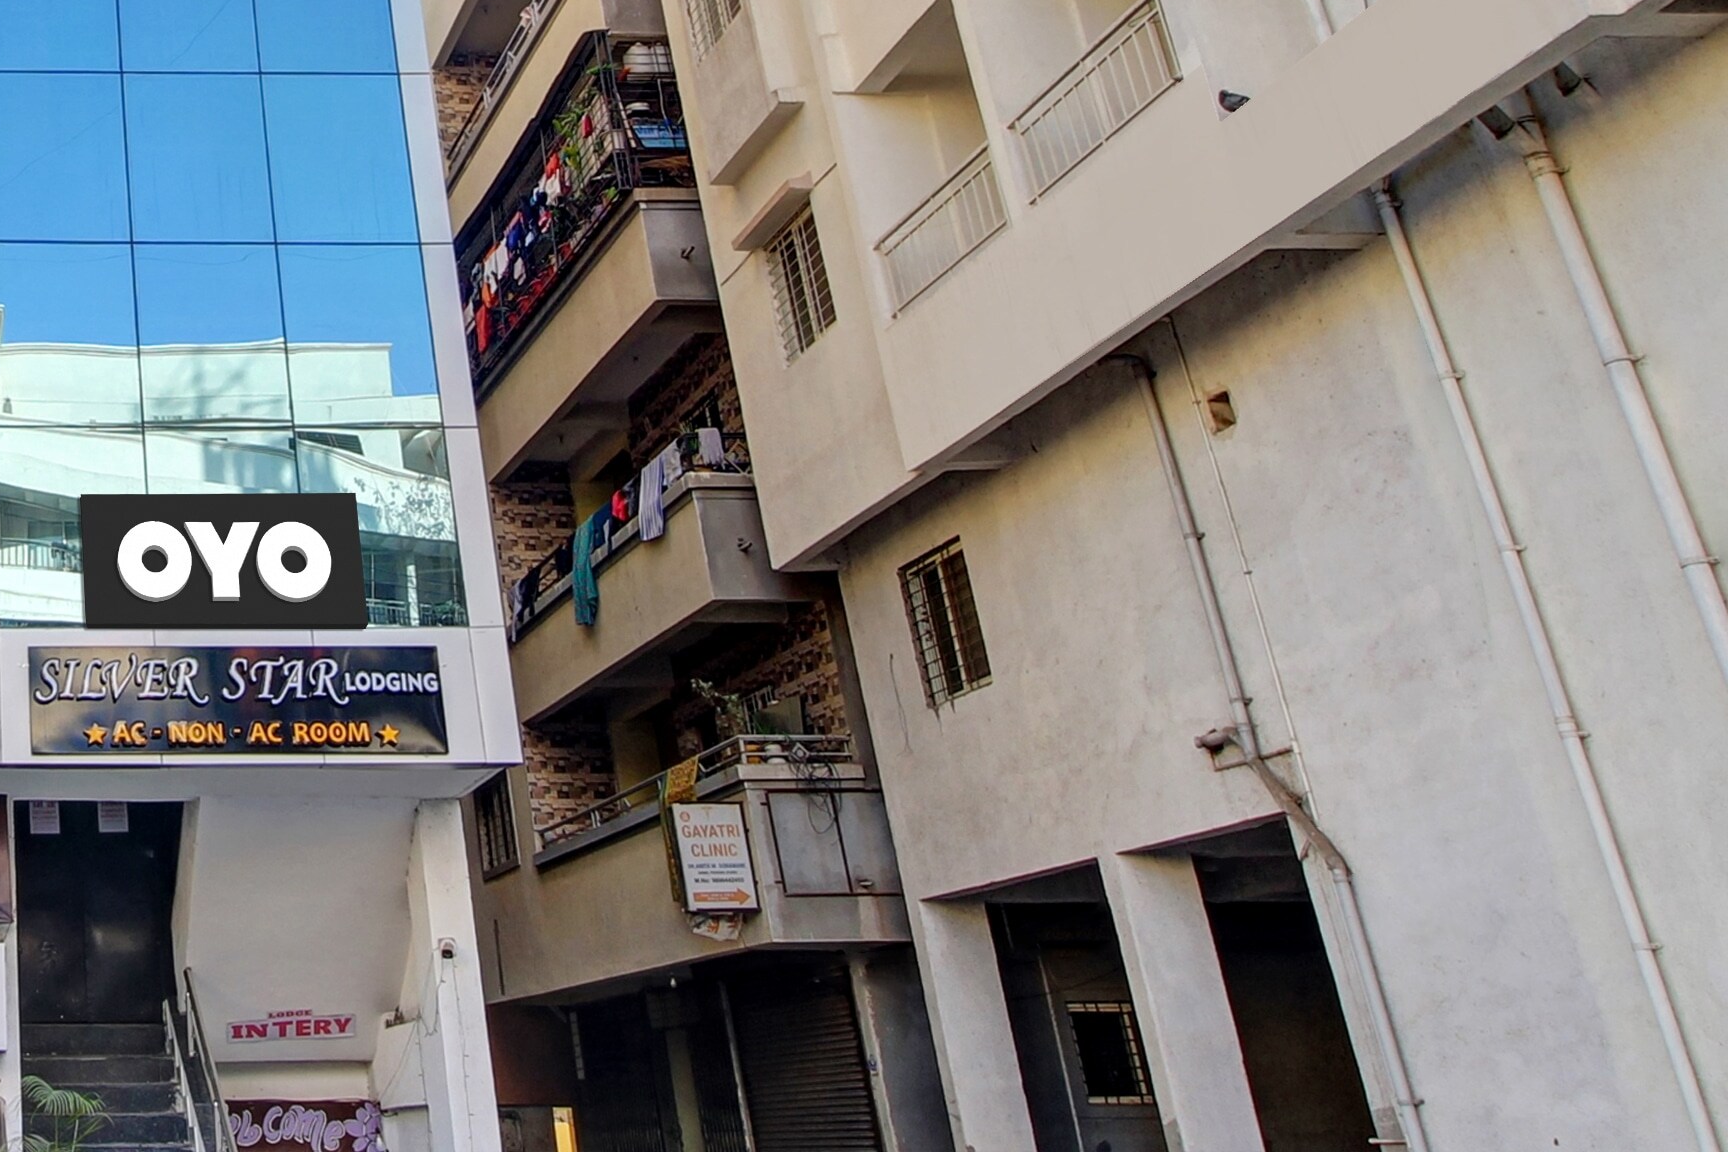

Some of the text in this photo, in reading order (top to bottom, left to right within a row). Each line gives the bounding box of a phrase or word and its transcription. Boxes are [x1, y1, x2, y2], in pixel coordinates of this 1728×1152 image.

[117, 520, 332, 603] OYO
[34, 653, 439, 706] SILVER STAR LODGING
[112, 720, 147, 746] AC
[168, 720, 226, 746] NON
[247, 720, 282, 745] AC
[292, 720, 371, 745] ROOM
[681, 824, 741, 839] GAYATRI
[691, 843, 738, 858] CLINIC
